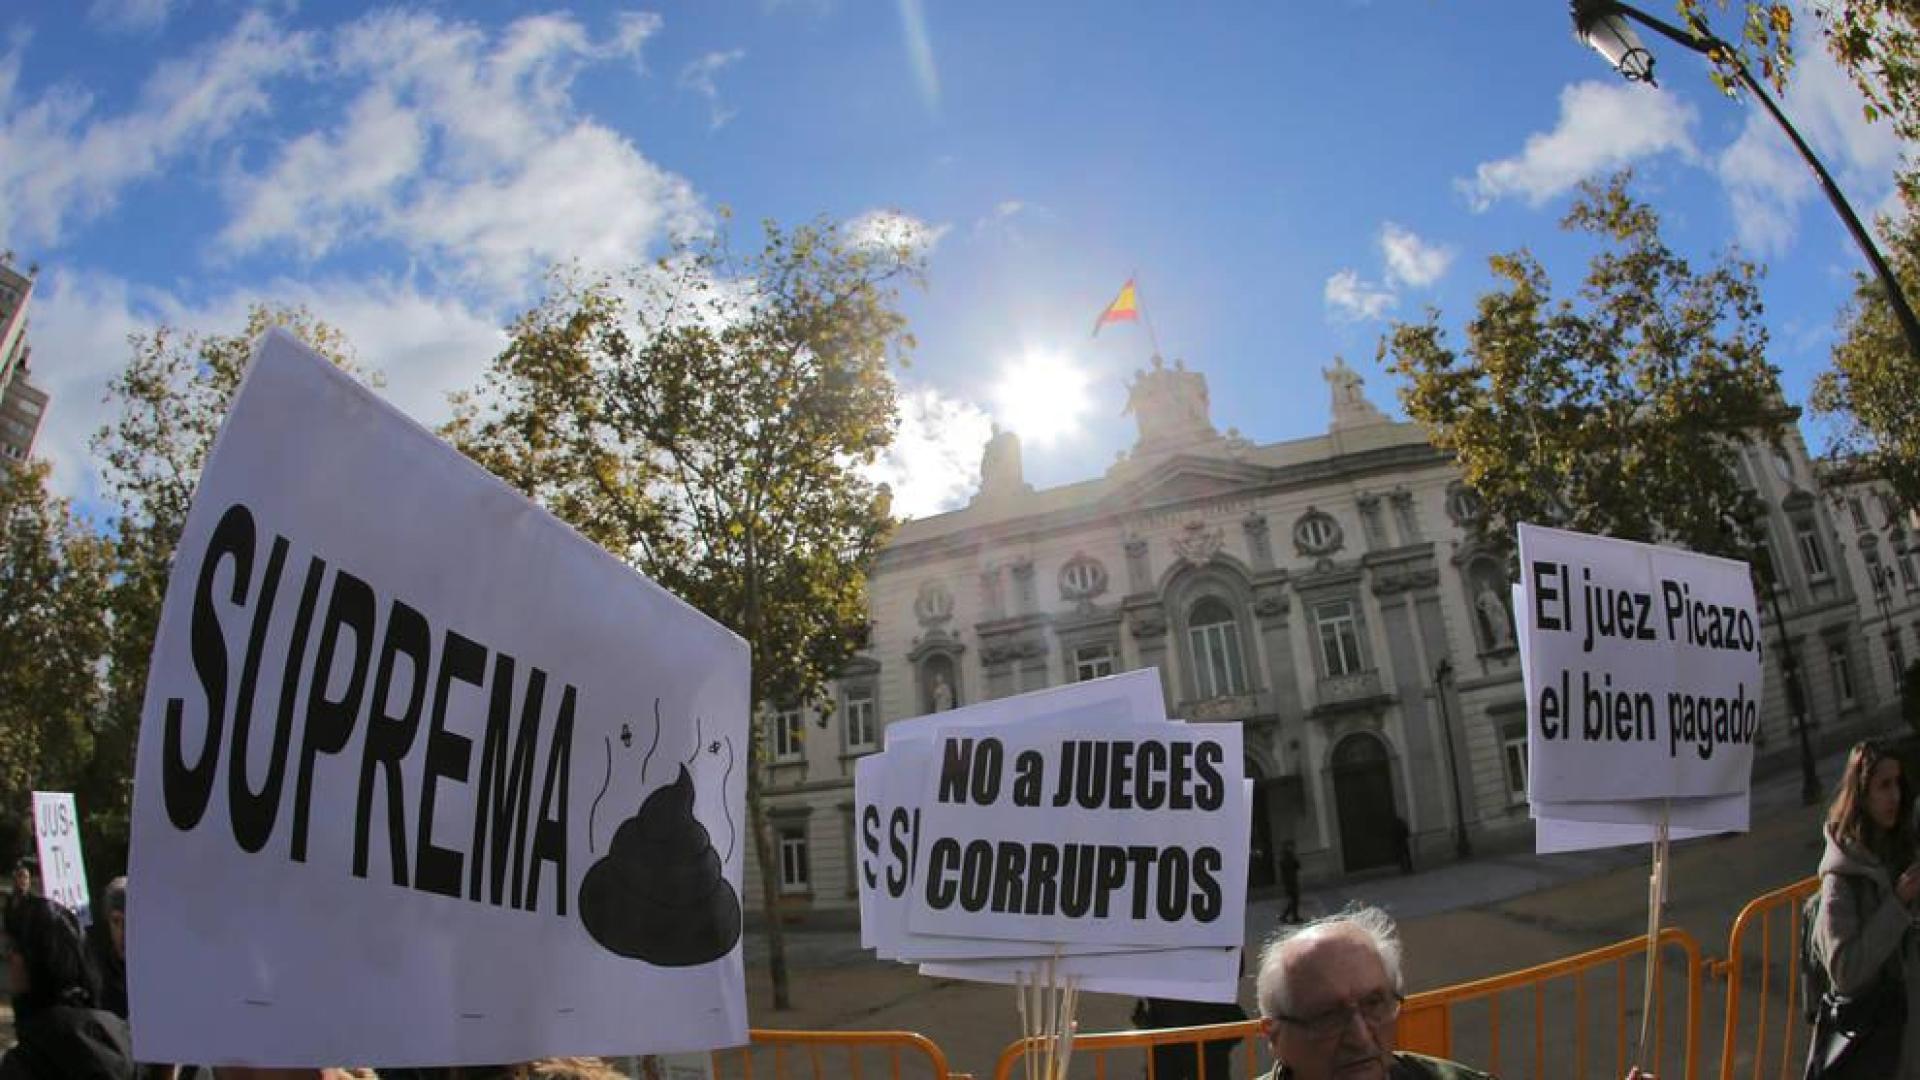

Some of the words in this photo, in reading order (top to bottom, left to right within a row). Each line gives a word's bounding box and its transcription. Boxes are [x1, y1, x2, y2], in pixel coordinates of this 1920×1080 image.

[1533, 561, 1572, 632] El
[1582, 567, 1657, 653] juez
[1661, 579, 1762, 664] Picazo,
[162, 503, 578, 917] SUPREMA
[1539, 669, 1570, 742] el
[1581, 671, 1657, 743] bien
[1667, 681, 1756, 761] pagado
[938, 737, 1004, 807] NO
[1012, 749, 1044, 808] a
[1052, 740, 1225, 812] JUECES
[925, 837, 1223, 924] CORRUPTOS
